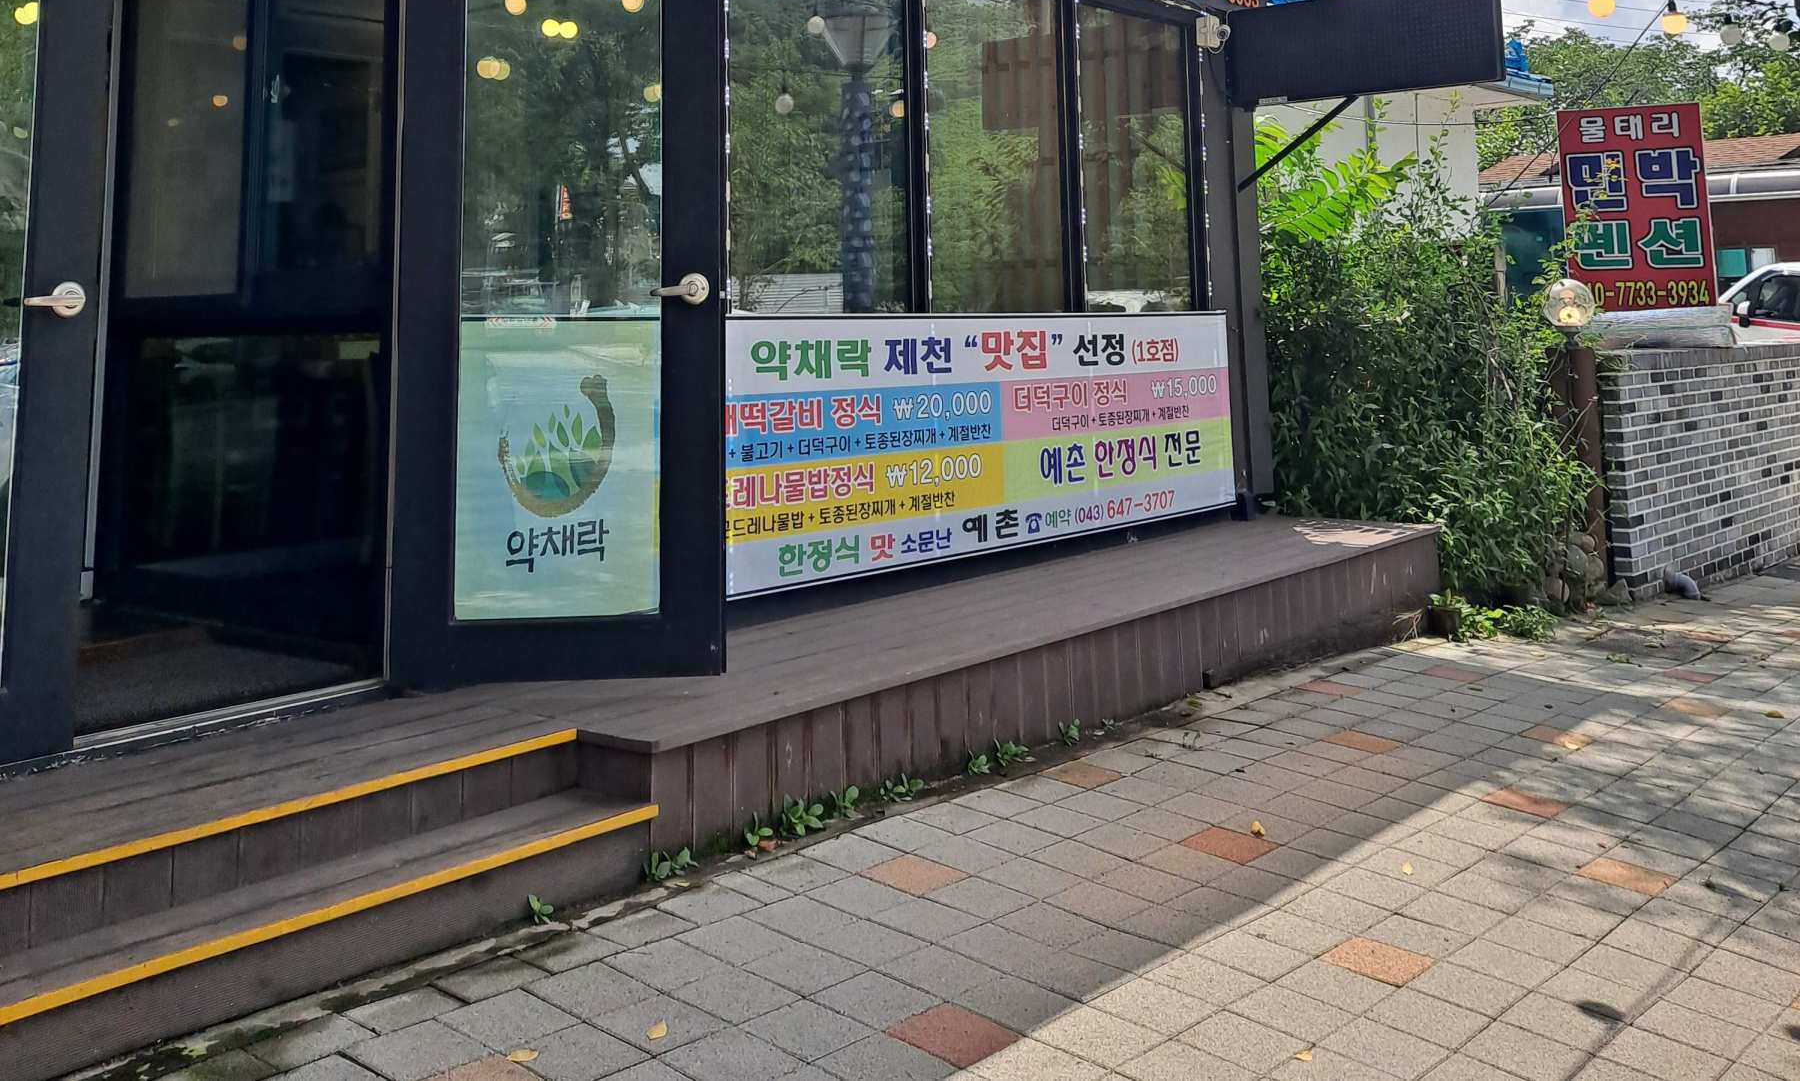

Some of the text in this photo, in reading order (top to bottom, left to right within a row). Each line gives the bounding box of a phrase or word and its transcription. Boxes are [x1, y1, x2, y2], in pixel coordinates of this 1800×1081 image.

[1579, 112, 1680, 142] 물태리
[1566, 148, 1700, 211] 민박
[1573, 218, 1704, 268] 펜션
[751, 339, 873, 381] 약채락
[884, 336, 953, 375] 제천
[1073, 333, 1126, 366] 선정
[1132, 338, 1179, 364] (1호점)
[831, 395, 882, 427] 정식
[893, 390, 993, 420] ₩20,000
[1013, 374, 1217, 412] 더덕구이 정식 ₩15,000
[740, 440, 783, 462] 불고기
[798, 434, 851, 456] 더덕구이
[865, 428, 937, 450] 토종된장찌개
[948, 423, 992, 442] 계절반찬
[1052, 414, 1089, 431] 더덕구이
[725, 453, 982, 509] 레나물밥정식 ₩12,000
[1039, 430, 1201, 486] 예촌 한정식 전문
[819, 499, 896, 525] 토종된장찌개
[909, 491, 955, 511] 계절반찬
[506, 519, 610, 573] 약채락
[777, 489, 1176, 578] 한정식 맛 소문난 예촌 예약 (043) 647-3707
